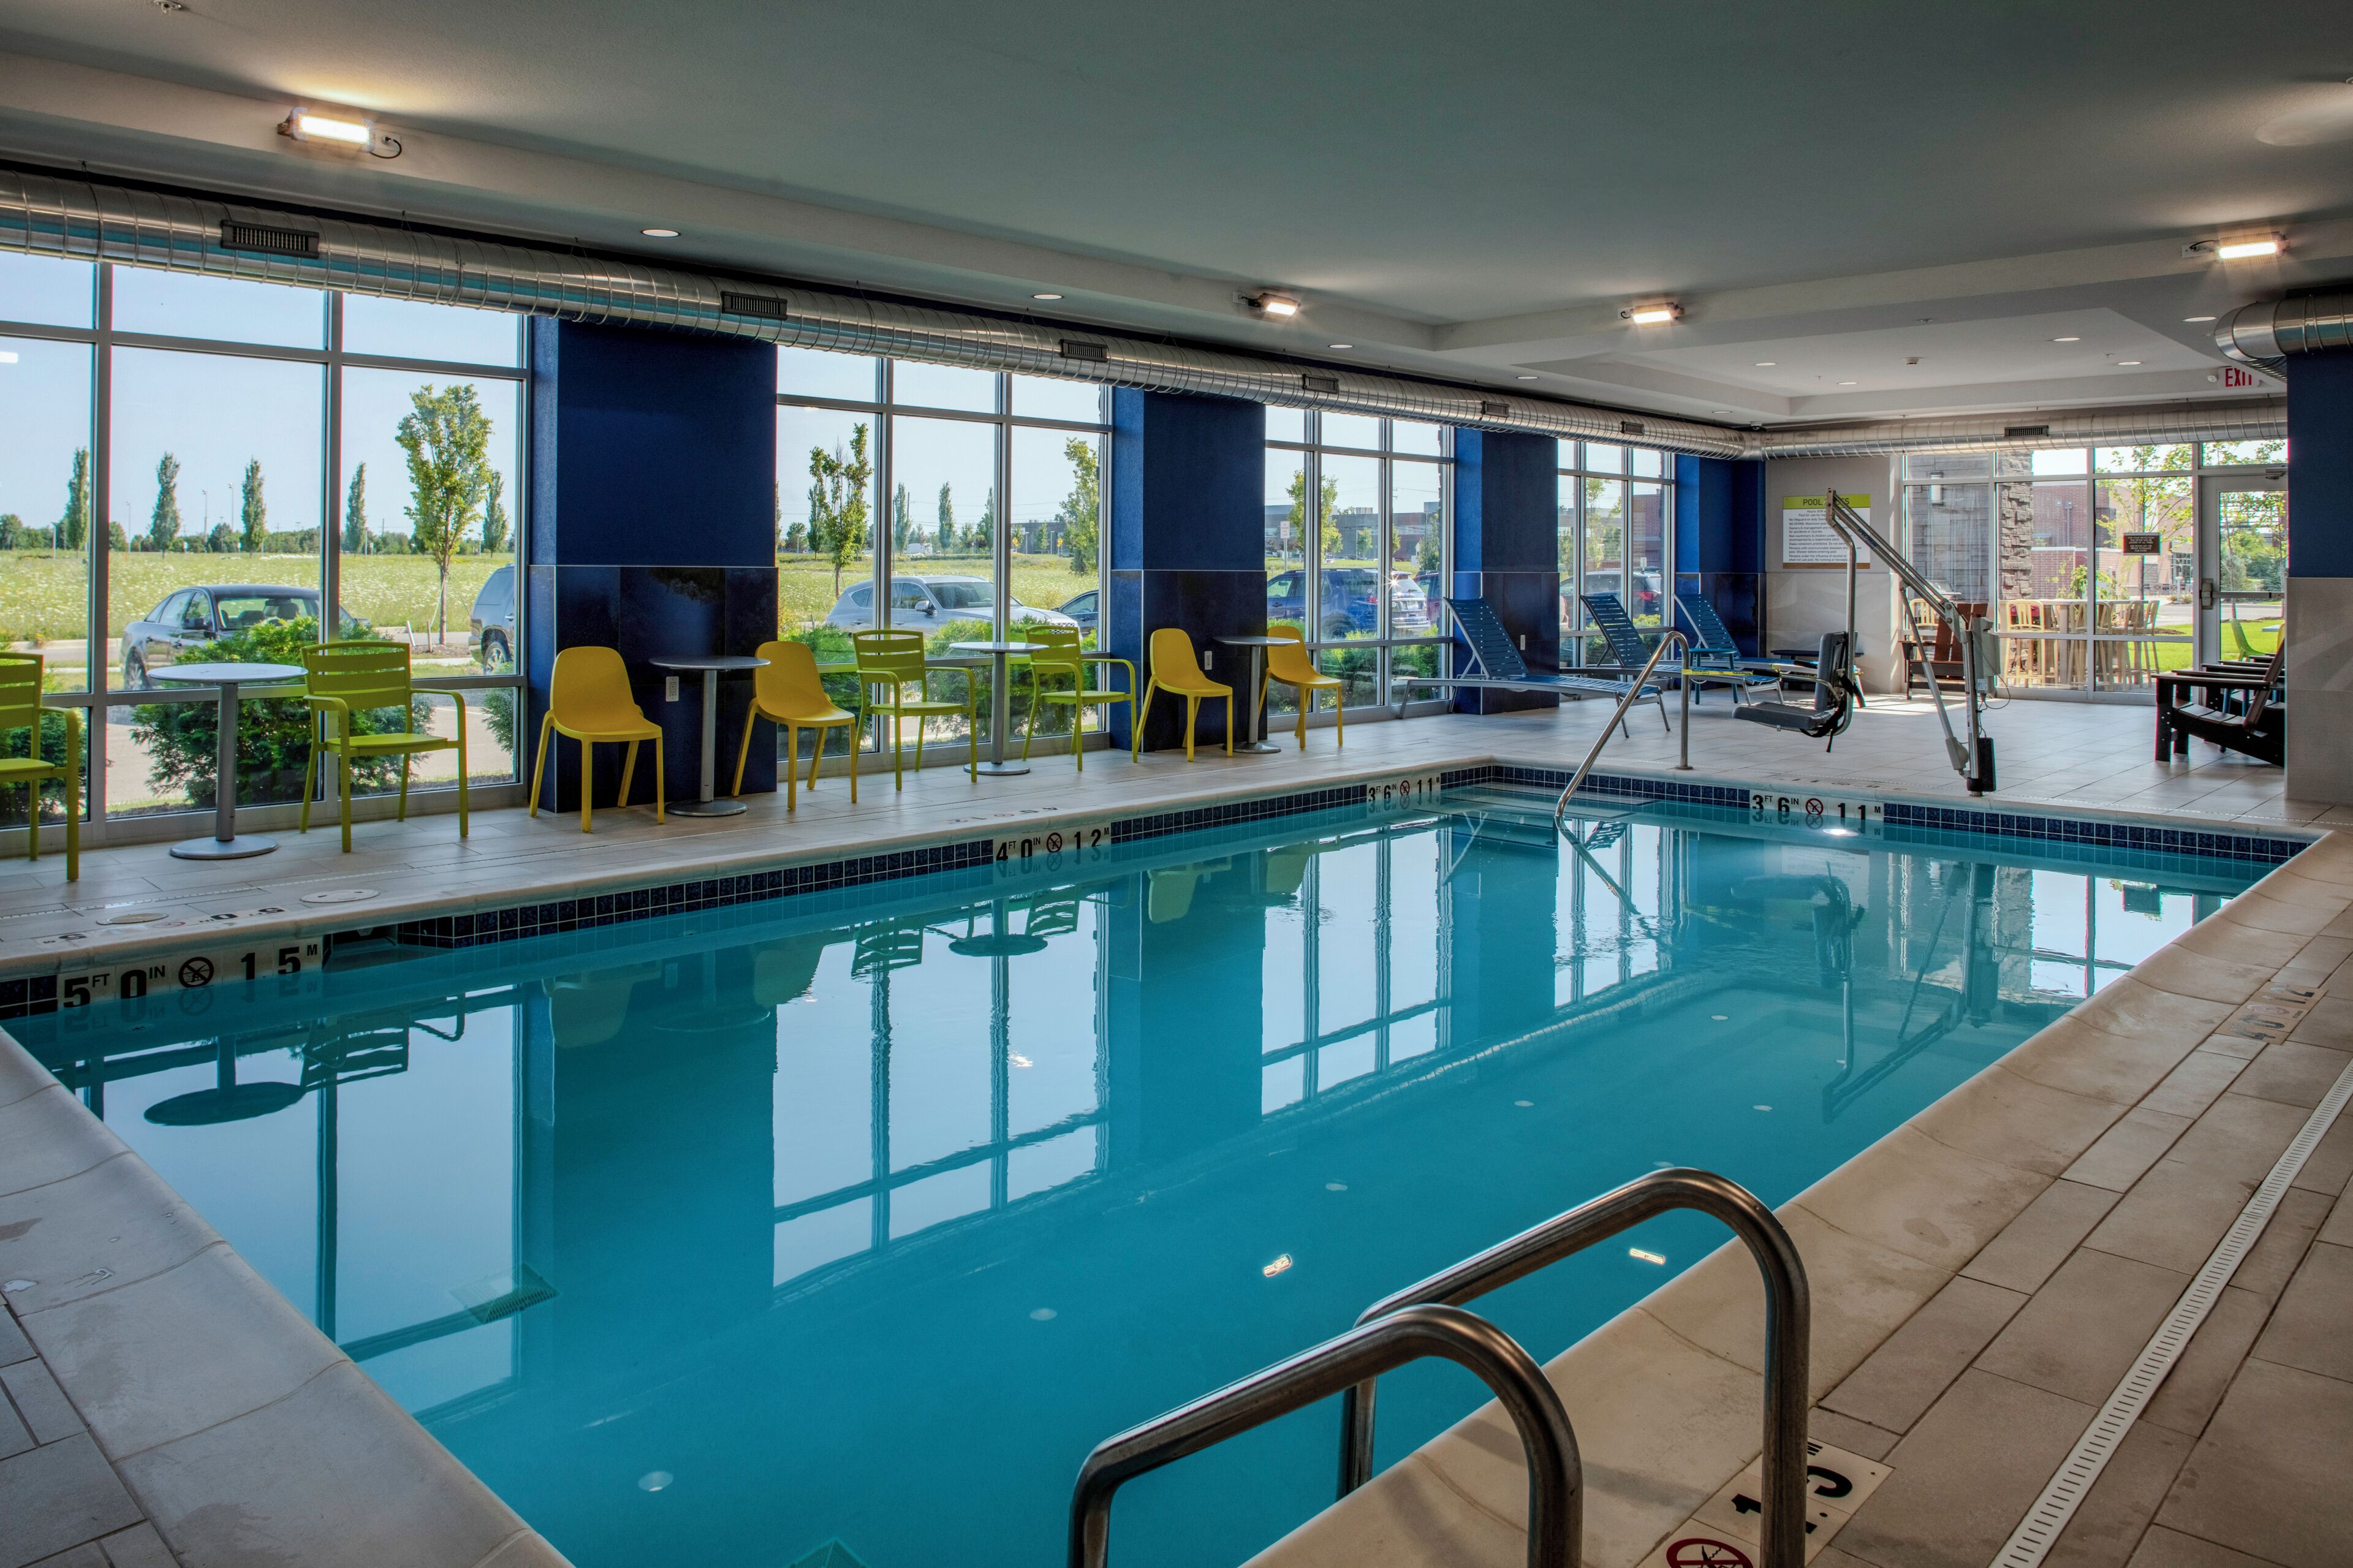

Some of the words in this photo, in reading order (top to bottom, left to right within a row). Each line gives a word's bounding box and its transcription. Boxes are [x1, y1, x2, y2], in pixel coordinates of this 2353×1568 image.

[1368, 787, 1376, 801] 3
[1384, 785, 1391, 798] 6
[1752, 795, 1764, 809] 3
[1778, 797, 1790, 811] 6
[996, 842, 1008, 862] 4
[1009, 841, 1017, 849] FT
[1021, 839, 1033, 858] 0
[307, 944, 317, 956] M
[63, 977, 90, 1007] 5
[93, 974, 110, 988] FT
[121, 969, 147, 999] 0
[149, 966, 165, 979] IN
